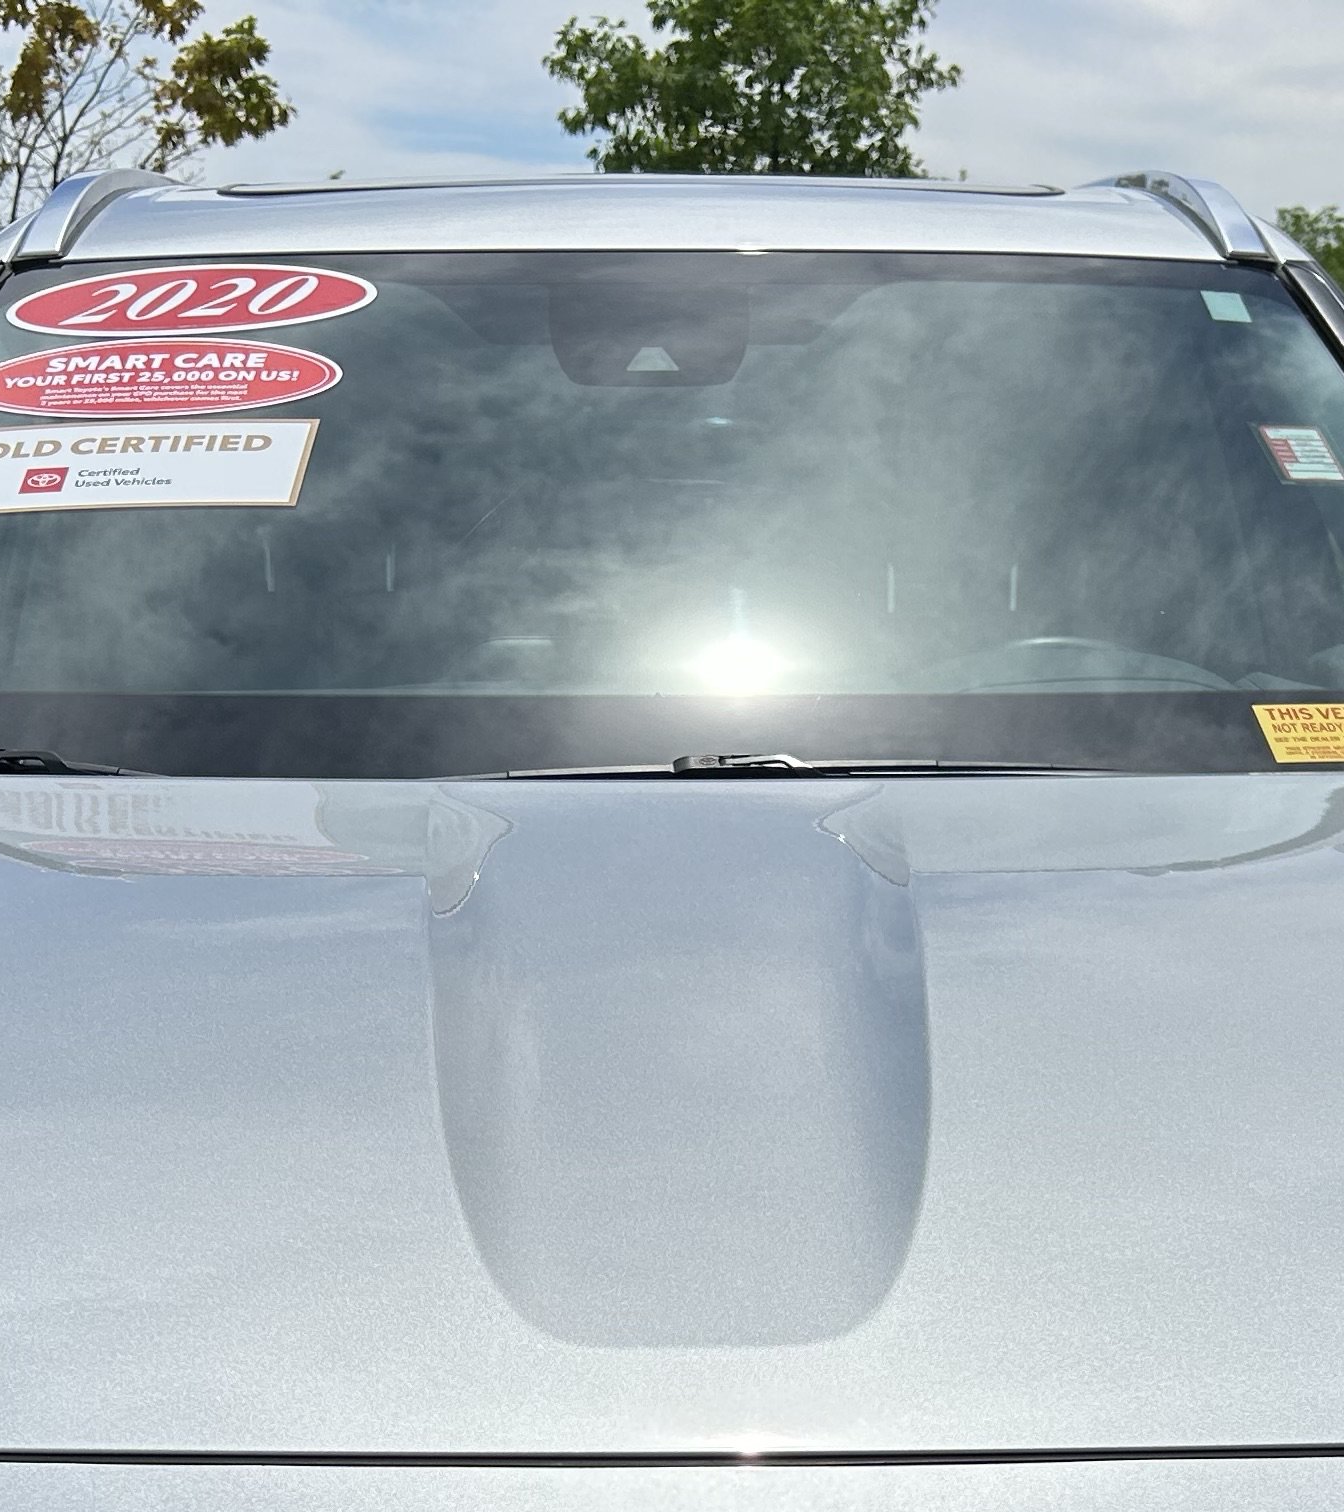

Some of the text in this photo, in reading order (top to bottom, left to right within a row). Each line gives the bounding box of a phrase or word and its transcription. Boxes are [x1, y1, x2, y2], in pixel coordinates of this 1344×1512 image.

[58, 275, 319, 326] 2020
[45, 352, 268, 372] SMART CARE
[5, 369, 300, 388] YOUR FIRST 25,000 ON US!
[69, 434, 273, 456] CERTIFIED
[78, 467, 141, 478] Certified
[74, 476, 173, 489] Used Vehicles
[1263, 707, 1314, 720] THIS
[1272, 722, 1299, 733] NOT
[1302, 722, 1343, 733] READY
